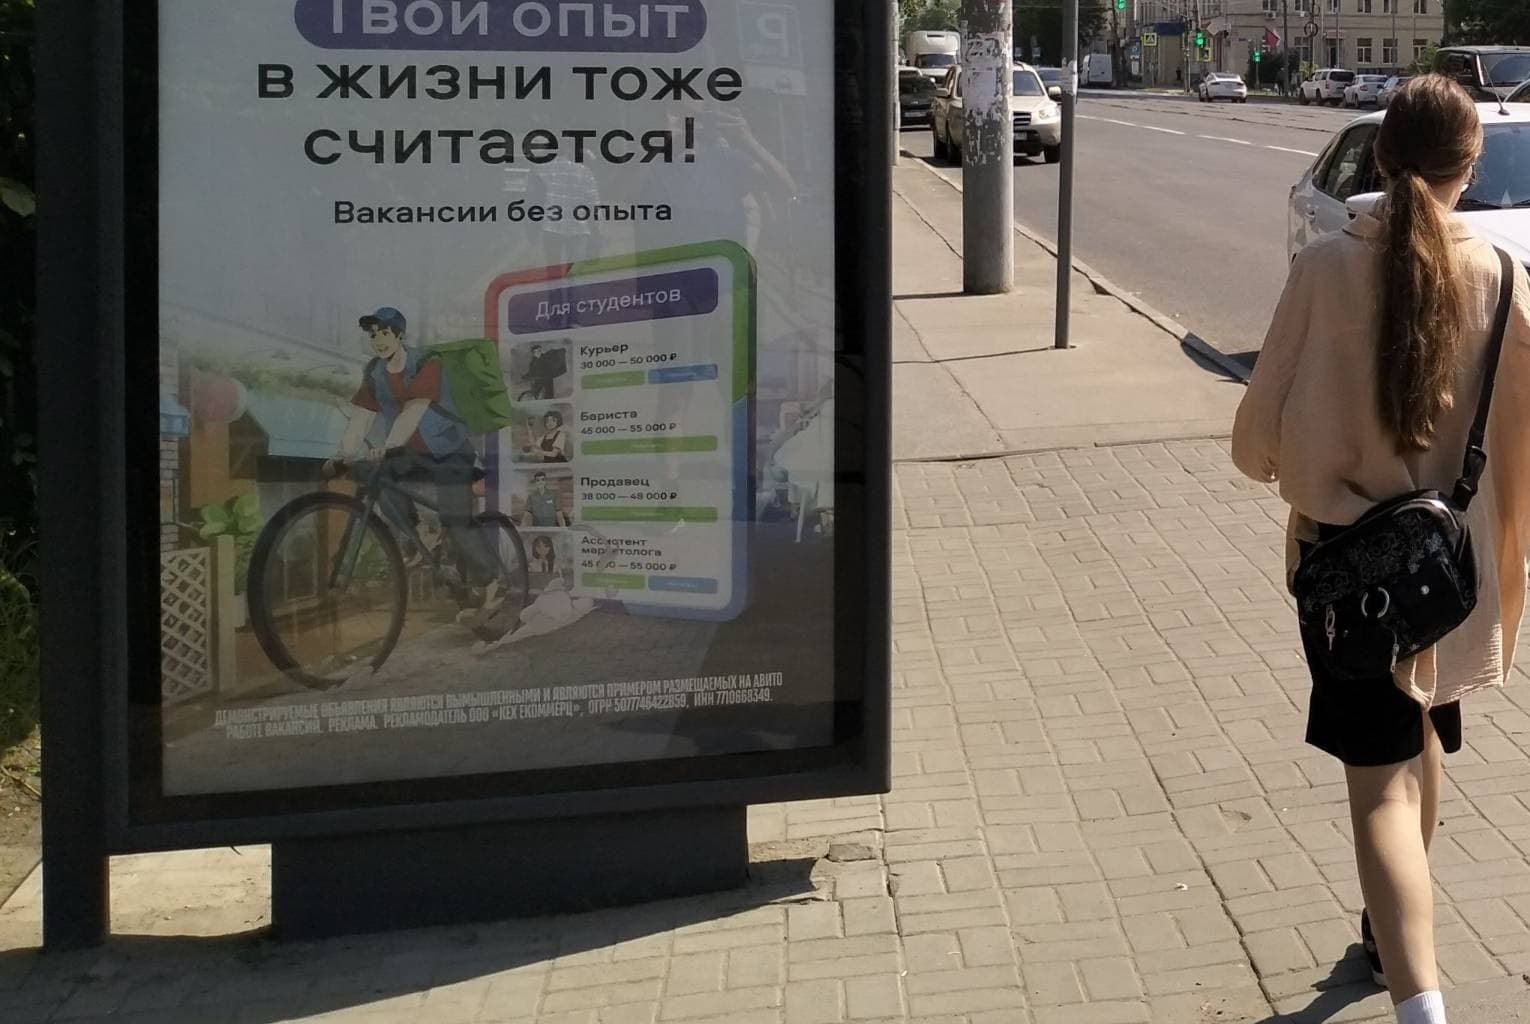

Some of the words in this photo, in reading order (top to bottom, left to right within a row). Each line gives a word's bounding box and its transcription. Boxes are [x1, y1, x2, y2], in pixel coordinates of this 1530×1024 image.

[512, 4, 690, 40] опыт
[256, 64, 295, 99] в
[316, 63, 553, 101] жизни
[573, 64, 744, 103] тоже
[303, 118, 697, 166] считается!
[333, 201, 498, 225] Вакансии
[507, 199, 564, 224] без
[572, 202, 673, 224] опыта
[536, 300, 571, 320] Для
[576, 287, 681, 315] студентов
[580, 343, 629, 358] Курьер
[596, 359, 616, 368] 000
[630, 357, 644, 365] 50
[646, 354, 667, 363] 000
[580, 410, 638, 423] Бариста
[596, 426, 616, 434] 000
[630, 424, 644, 432] 55
[646, 423, 667, 432] 000
[580, 477, 650, 489] Продавец
[596, 492, 616, 501] 000
[646, 492, 667, 501] 000
[645, 563, 667, 571] 000
[446, 688, 541, 708] ВЫМЫШЛЕННЫМИ
[543, 687, 550, 702] И
[552, 684, 605, 701] ЯВЛЯЮТСЯ
[607, 680, 662, 697] ПРИМЕРОМ
[663, 676, 737, 694] РАЗМЕЩАЕМЫХ
[738, 675, 751, 688] НА
[753, 672, 783, 687] АВИТО
[383, 707, 467, 729] РЕКЛАМОДАТЕЛЬ
[469, 706, 490, 722] ООО
[588, 697, 612, 714] ОГРН
[694, 691, 715, 707] ИНН
